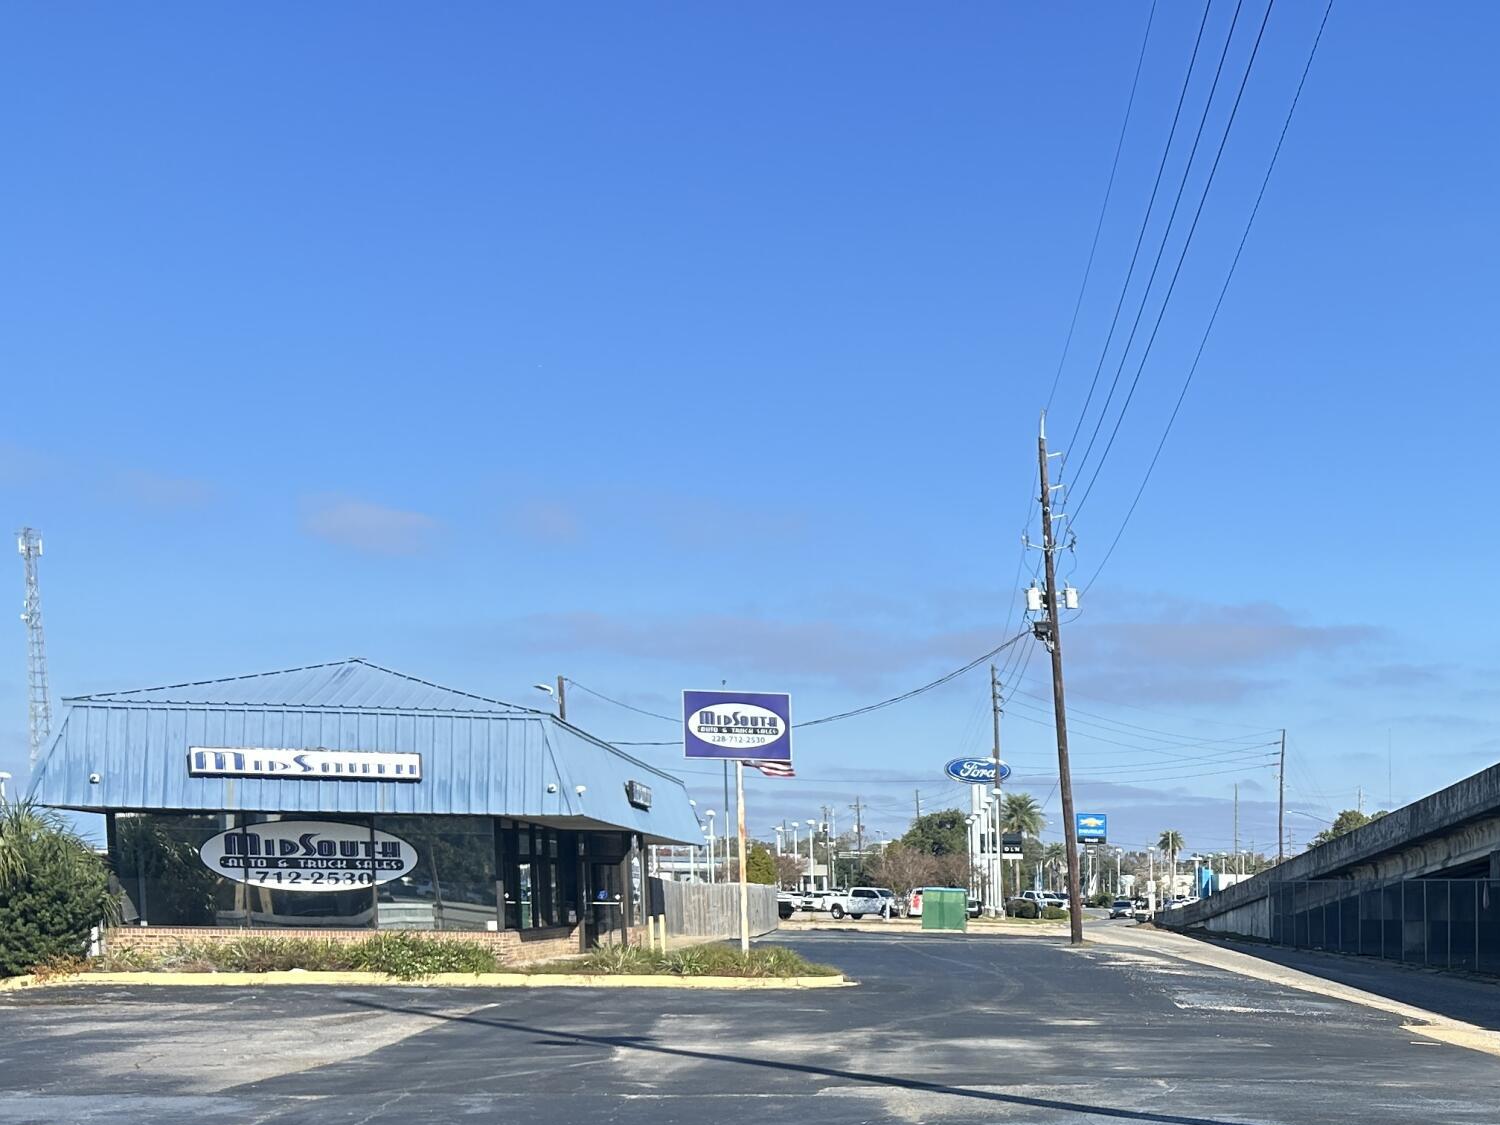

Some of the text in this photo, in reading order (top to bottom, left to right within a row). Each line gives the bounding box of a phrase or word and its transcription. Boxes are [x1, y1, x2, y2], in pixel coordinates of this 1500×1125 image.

[712, 735, 766, 743] 228-712-2530
[278, 859, 289, 868] &
[299, 859, 346, 869] TRUCK
[356, 860, 398, 870] SALES
[255, 871, 373, 885] 712-2530
